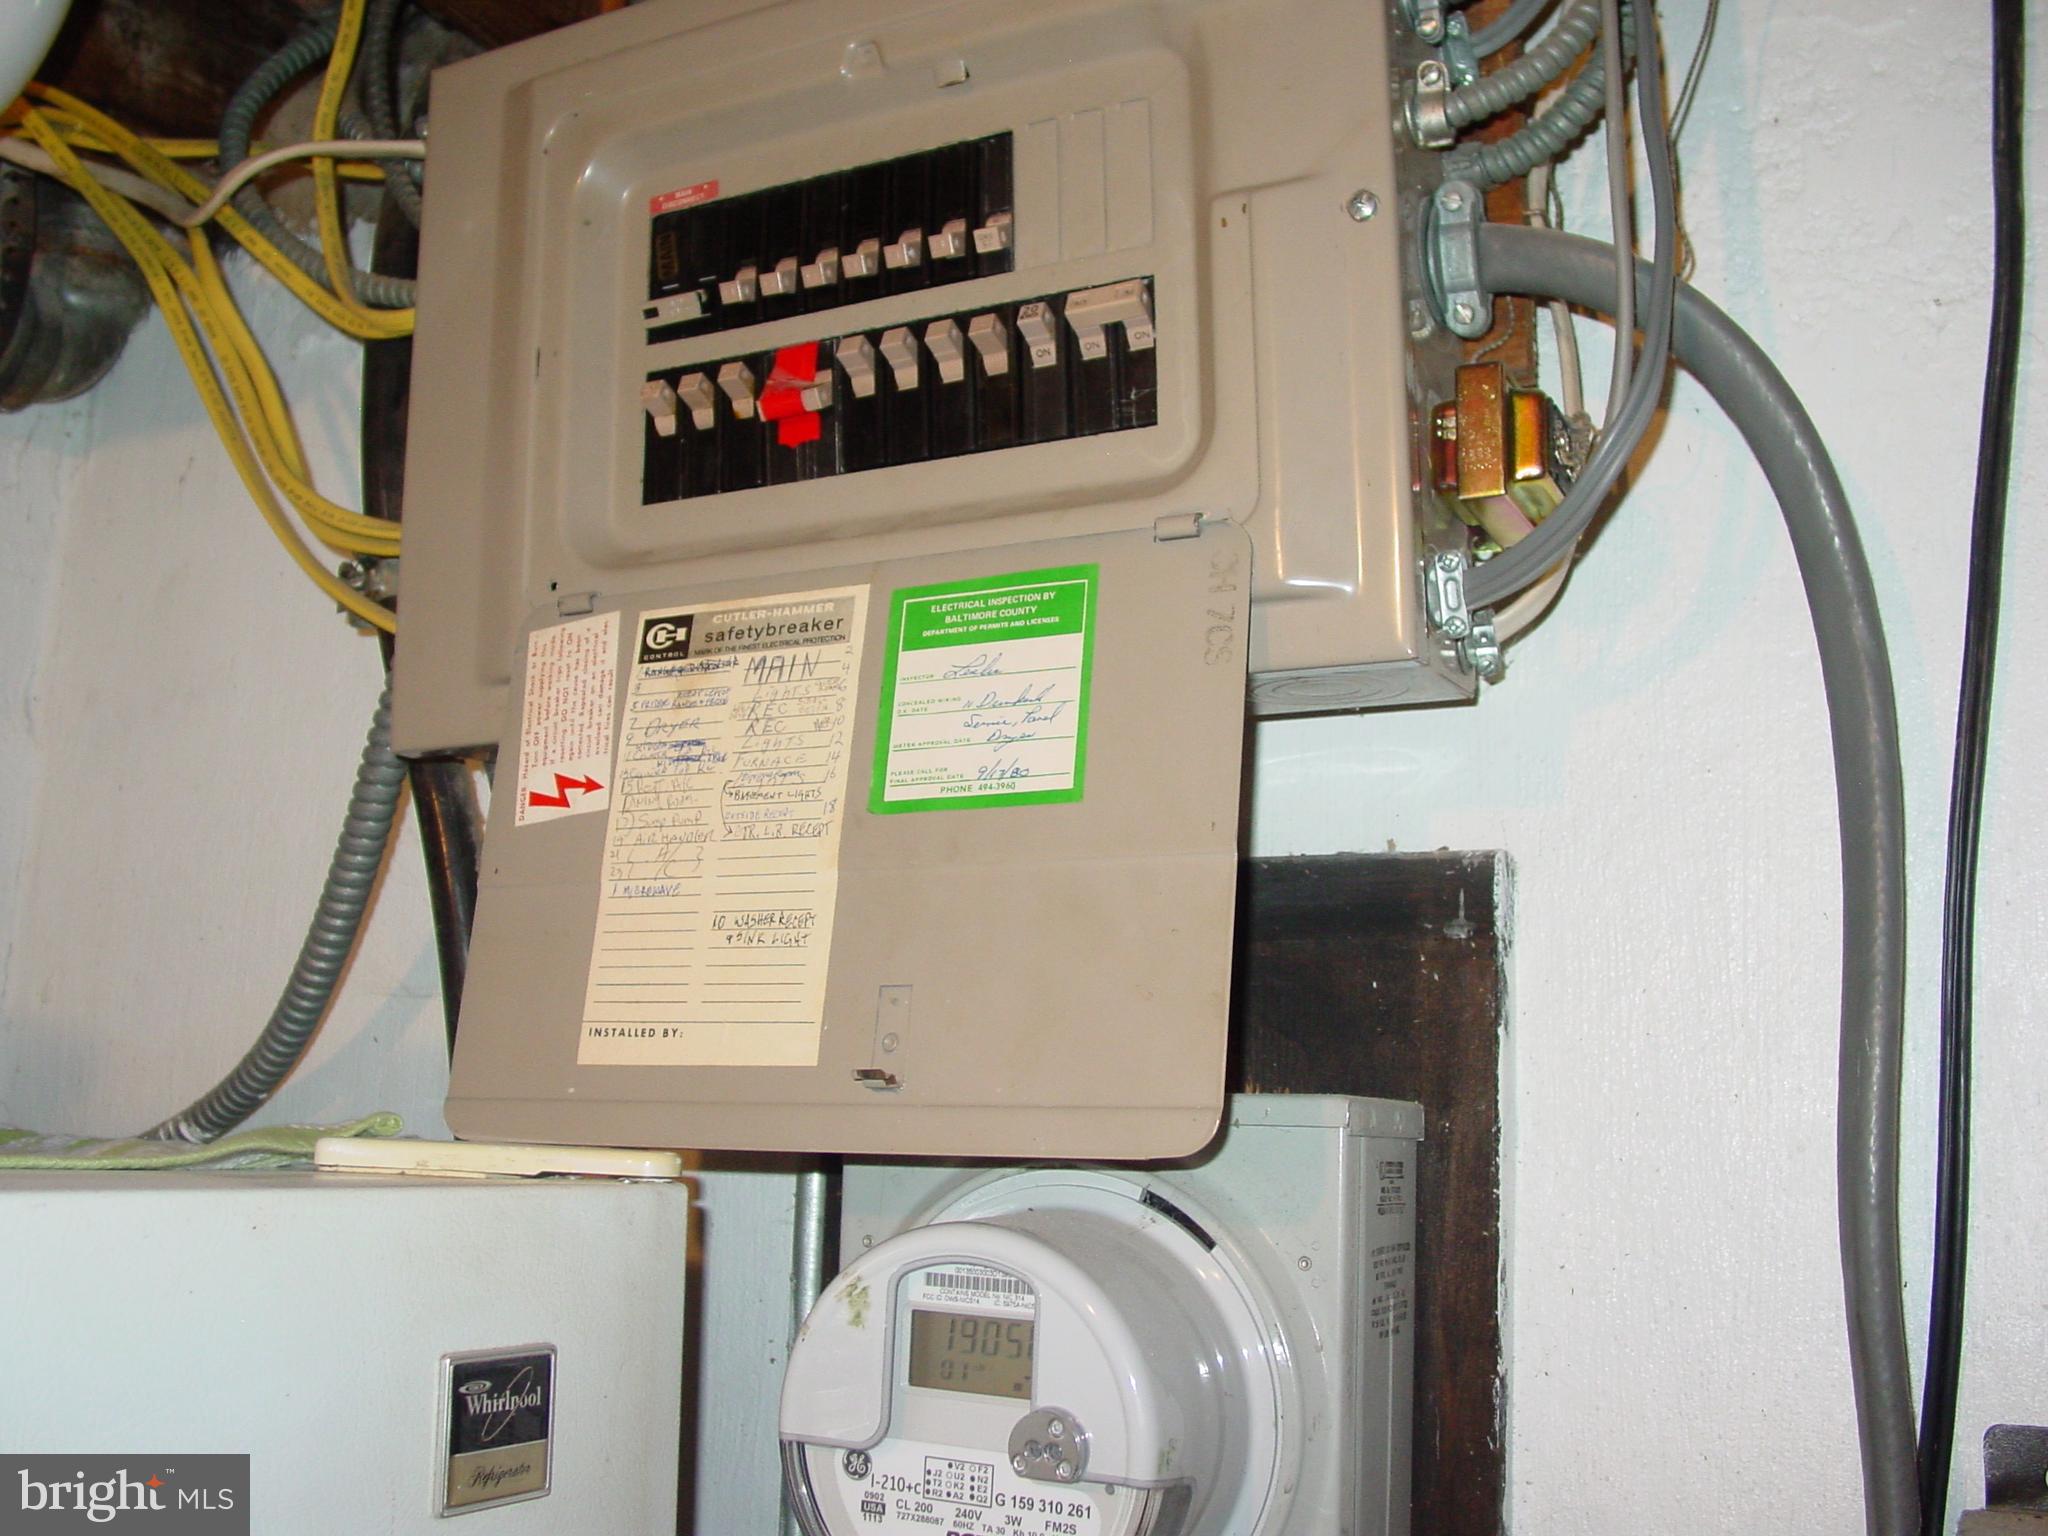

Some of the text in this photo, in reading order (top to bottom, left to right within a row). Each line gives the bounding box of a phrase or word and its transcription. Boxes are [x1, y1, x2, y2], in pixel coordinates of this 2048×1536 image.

[1134, 330, 1150, 340] ON
[1085, 342, 1100, 351] ON
[1036, 348, 1051, 358] ON
[931, 592, 1056, 613] ELECTRICAL INSPECTION BY
[945, 606, 1037, 624] BALTIMORE COUNTY
[704, 617, 844, 643] safetybreaker
[922, 626, 967, 637] DEPARTMENT
[979, 622, 1008, 630] PERMITS
[743, 649, 821, 684] MAIN
[940, 785, 972, 793] PHONE
[589, 1028, 684, 1038] INSTALLED BY:
[465, 1386, 541, 1416] Whirlpool
[978, 1466, 988, 1474] F2
[864, 1491, 885, 1500] 0902
[932, 1489, 943, 1497] R2
[863, 1502, 883, 1513] USA
[896, 1499, 933, 1513] CL 200
[995, 1492, 1091, 1519] G 159 310 261
[955, 1508, 982, 1521] 240V
[1004, 1515, 1022, 1526] 3W
[1045, 1521, 1077, 1535] FM2S
[982, 1524, 993, 1533] TA
[996, 1527, 1005, 1535] 30
